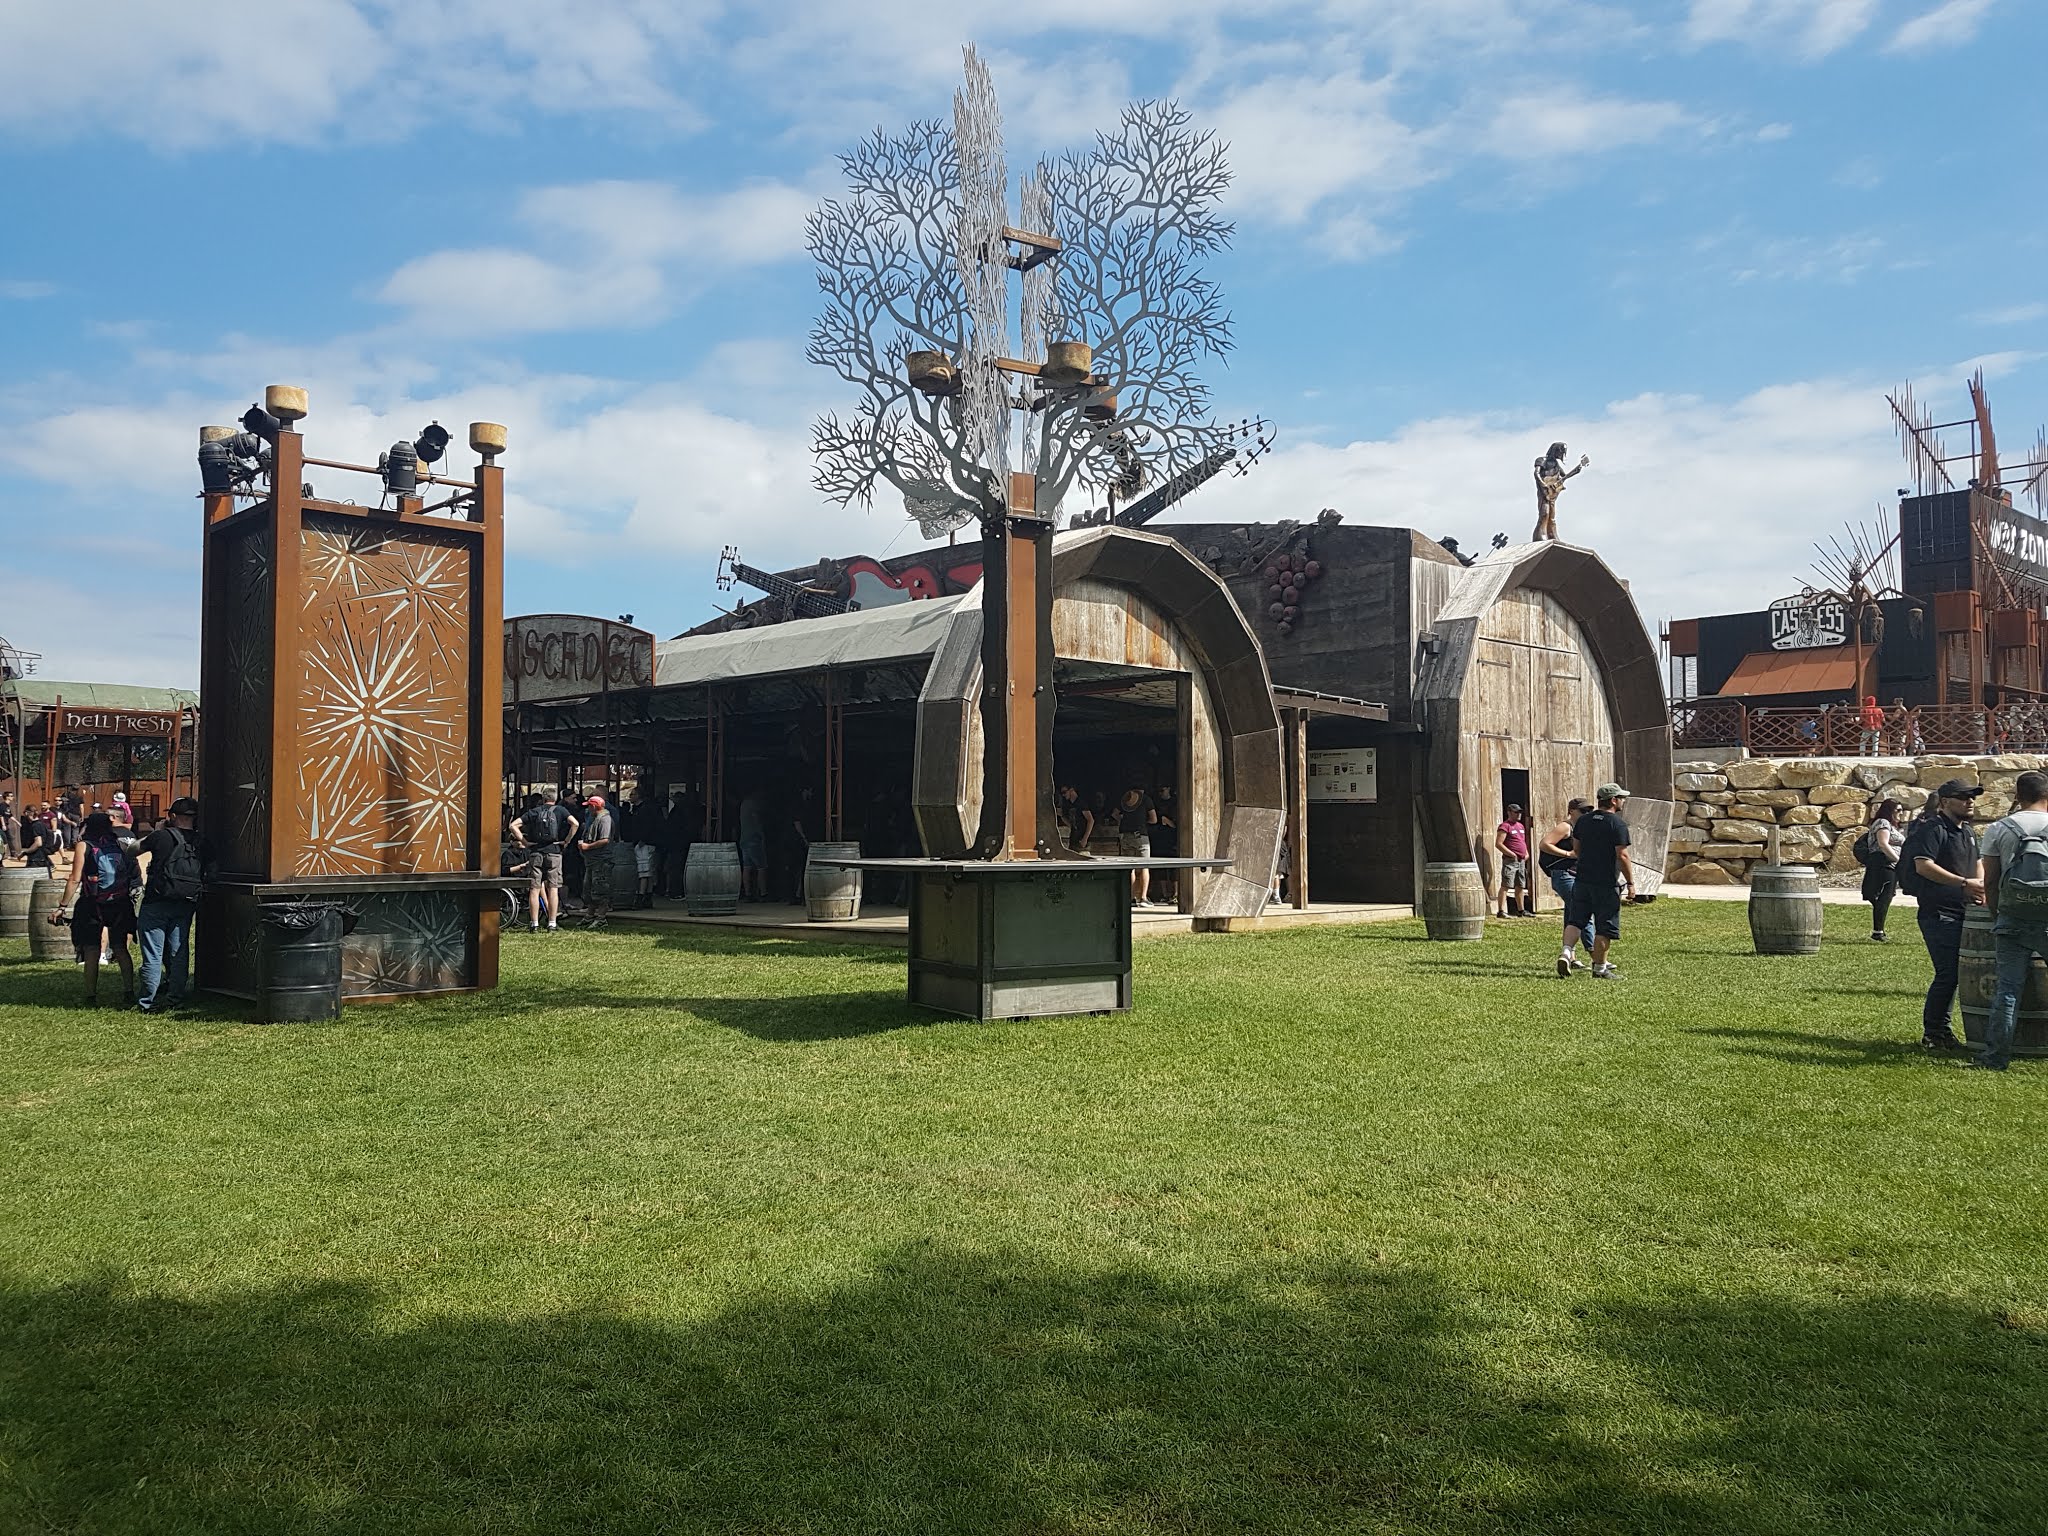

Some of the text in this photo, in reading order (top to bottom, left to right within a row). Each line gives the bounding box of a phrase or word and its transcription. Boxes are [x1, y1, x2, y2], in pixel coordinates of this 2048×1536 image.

[2020, 528, 2048, 568] ZON
[1771, 604, 1845, 639] CASESS
[503, 629, 652, 687] USCADET
